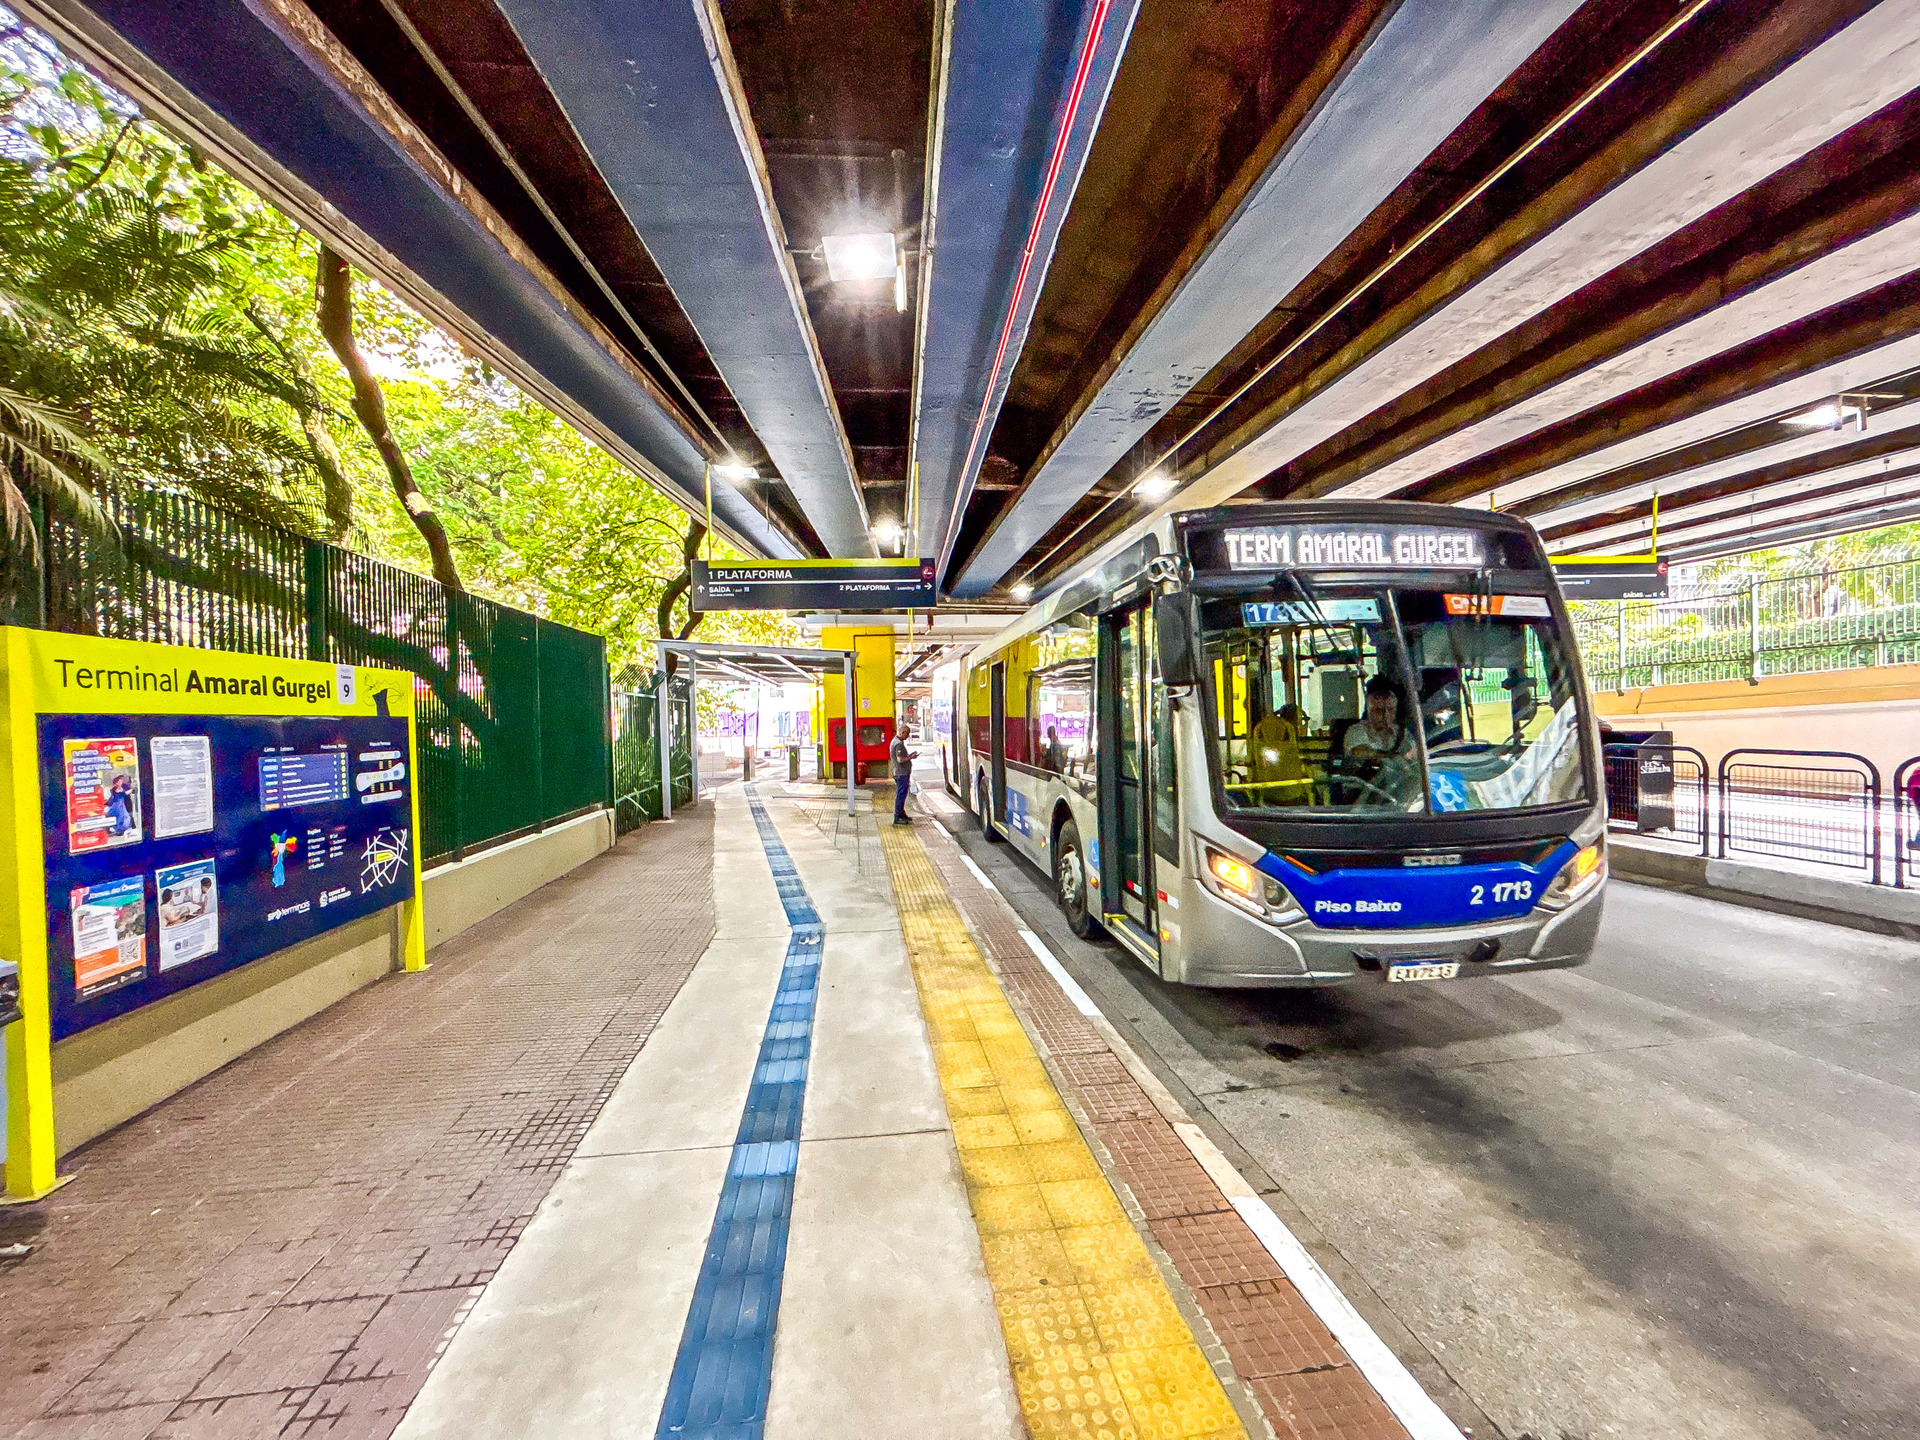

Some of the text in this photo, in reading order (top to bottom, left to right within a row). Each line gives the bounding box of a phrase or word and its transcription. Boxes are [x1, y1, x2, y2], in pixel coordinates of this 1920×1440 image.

[1297, 532, 1391, 564] AMARAL
[1393, 533, 1484, 565] GURGEL
[708, 569, 793, 580] 1 PLATAFORMA
[709, 585, 731, 593] SAÍDA
[845, 584, 891, 592] PLATAFORMA
[54, 658, 332, 704] Terminal Amaral Gurgel
[343, 683, 350, 698] 9
[1470, 880, 1532, 905] 2 1713
[1315, 899, 1402, 913] Piso Baixo
